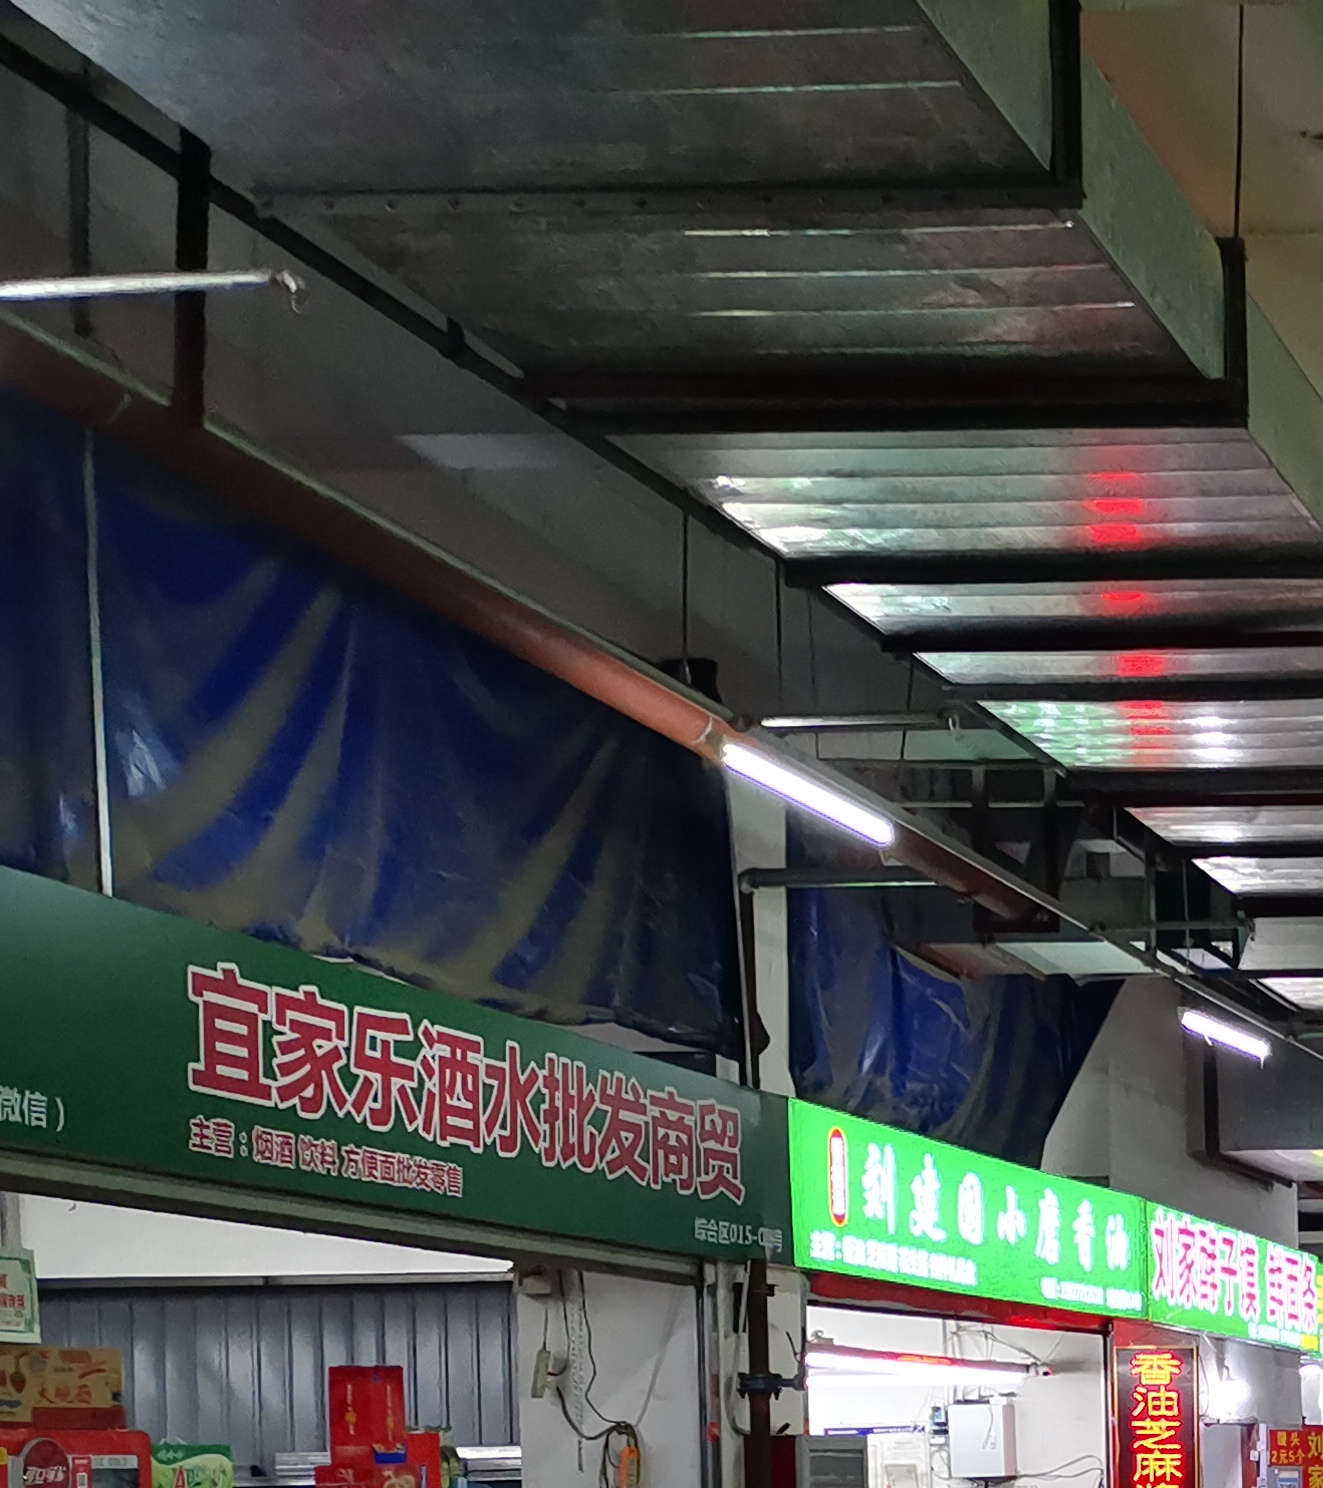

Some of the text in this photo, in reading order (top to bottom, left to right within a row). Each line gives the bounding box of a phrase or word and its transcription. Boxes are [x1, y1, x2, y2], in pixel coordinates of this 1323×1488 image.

[187, 961, 747, 1206] 宜家乐酒水批发商贸
